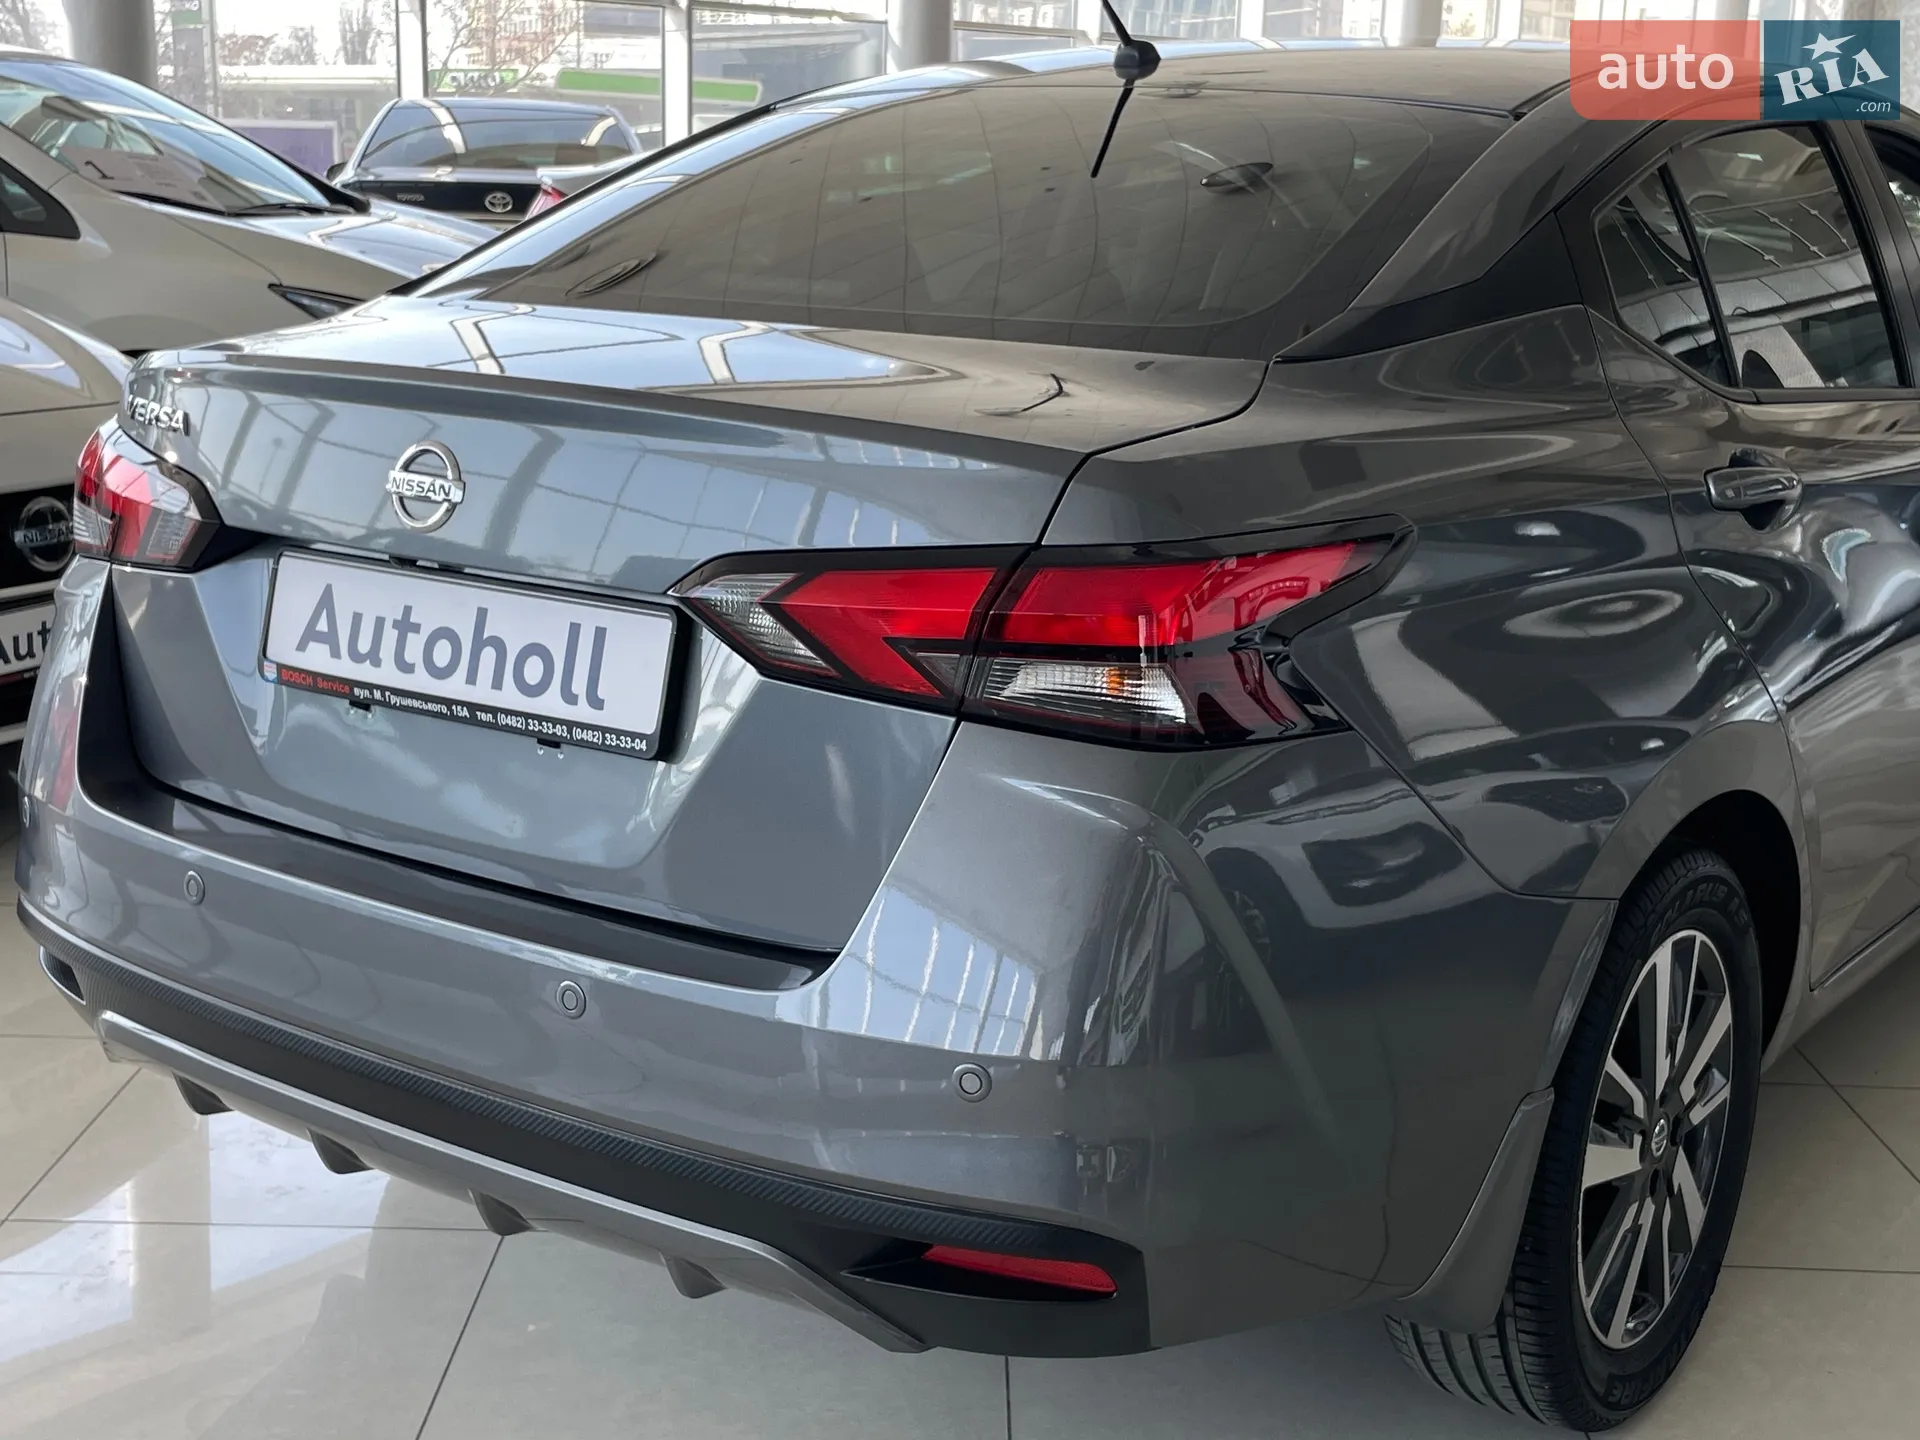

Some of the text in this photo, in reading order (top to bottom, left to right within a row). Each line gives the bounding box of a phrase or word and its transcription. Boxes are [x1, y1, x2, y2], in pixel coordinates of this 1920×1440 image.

[127, 395, 186, 436] VERSA
[391, 476, 452, 498] NISSAN
[295, 583, 608, 711] Autoholl
[281, 669, 314, 687] BOSCH
[317, 678, 350, 694] Service
[353, 686, 373, 699] вул.
[476, 711, 496, 724] тел.
[497, 713, 526, 730] (0482)
[527, 719, 570, 740] 33-33-03,
[572, 727, 603, 746] (0482)
[604, 733, 647, 752] 33-33-04
